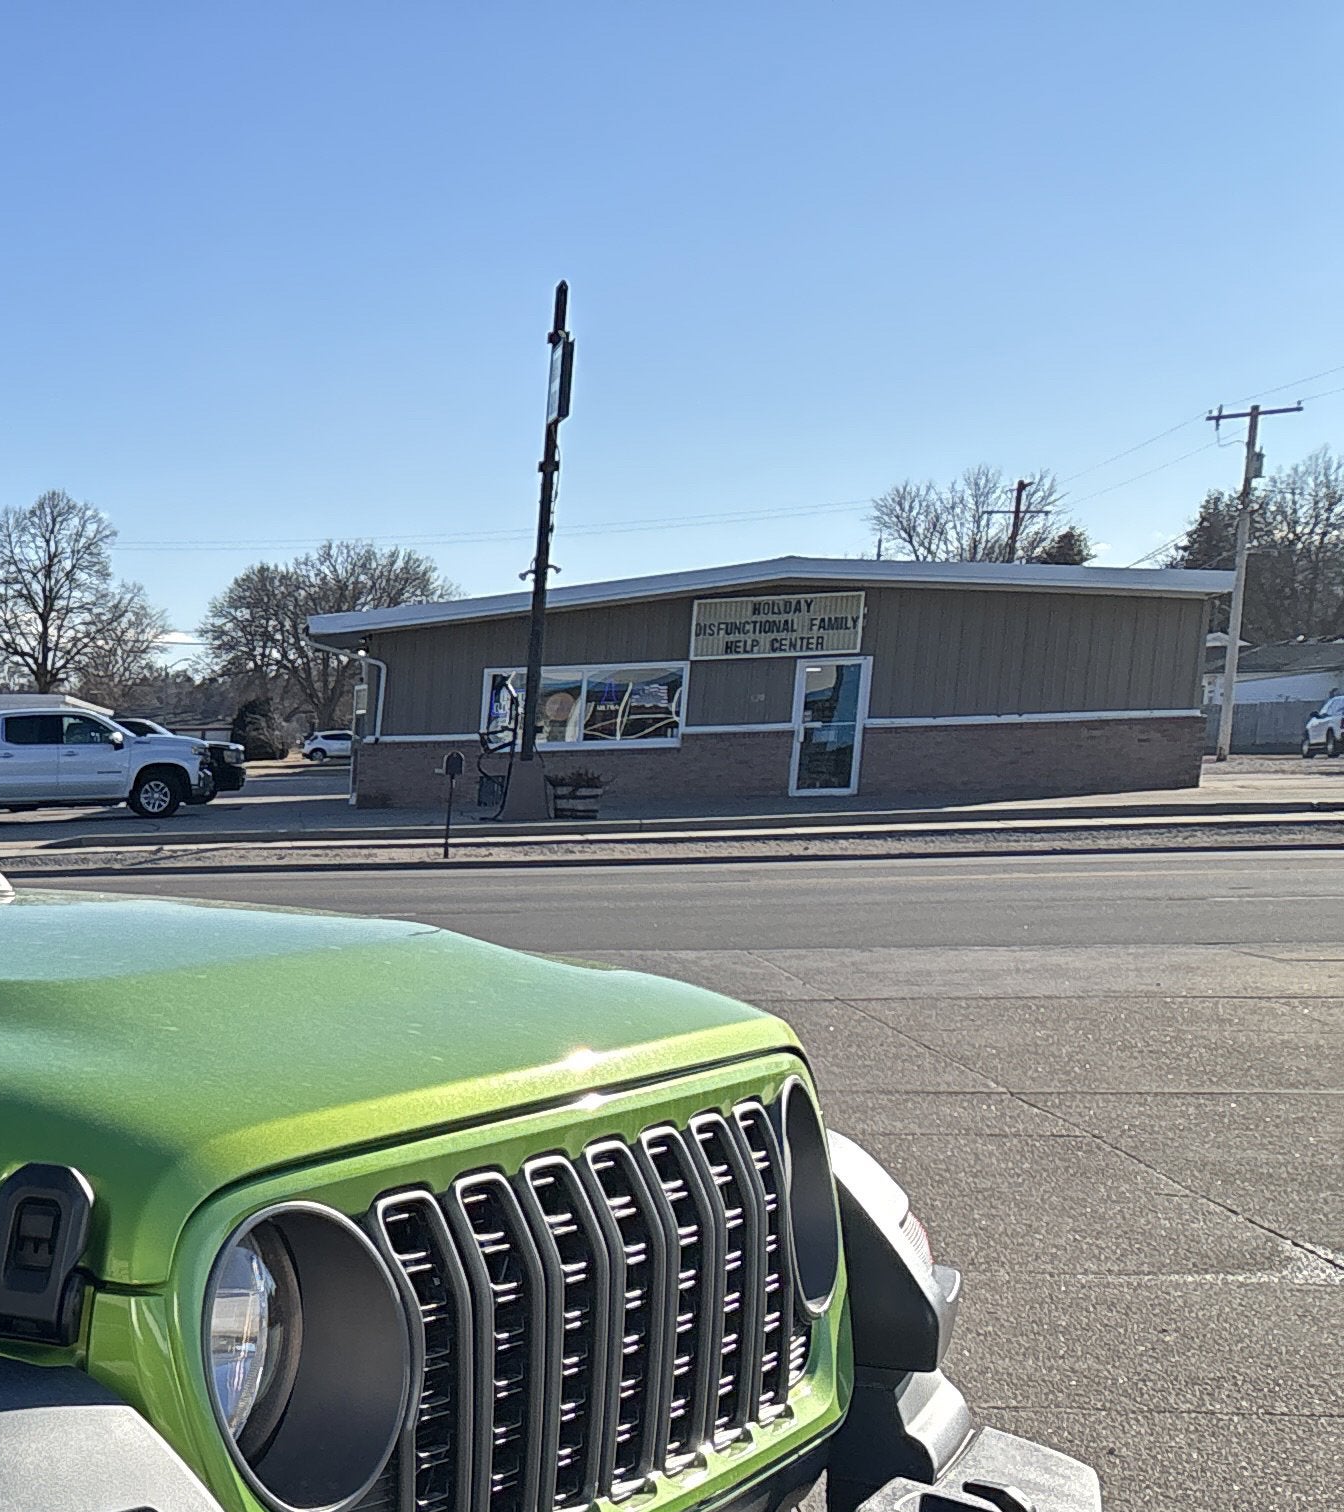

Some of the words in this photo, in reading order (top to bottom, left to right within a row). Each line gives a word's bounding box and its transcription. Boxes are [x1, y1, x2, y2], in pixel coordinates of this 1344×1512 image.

[752, 600, 814, 616] HOLIDAY
[695, 622, 797, 637] DISFUNCTIONAL
[810, 615, 859, 632] FAMILY
[725, 639, 759, 654] HELP
[771, 636, 824, 652] CENTER
